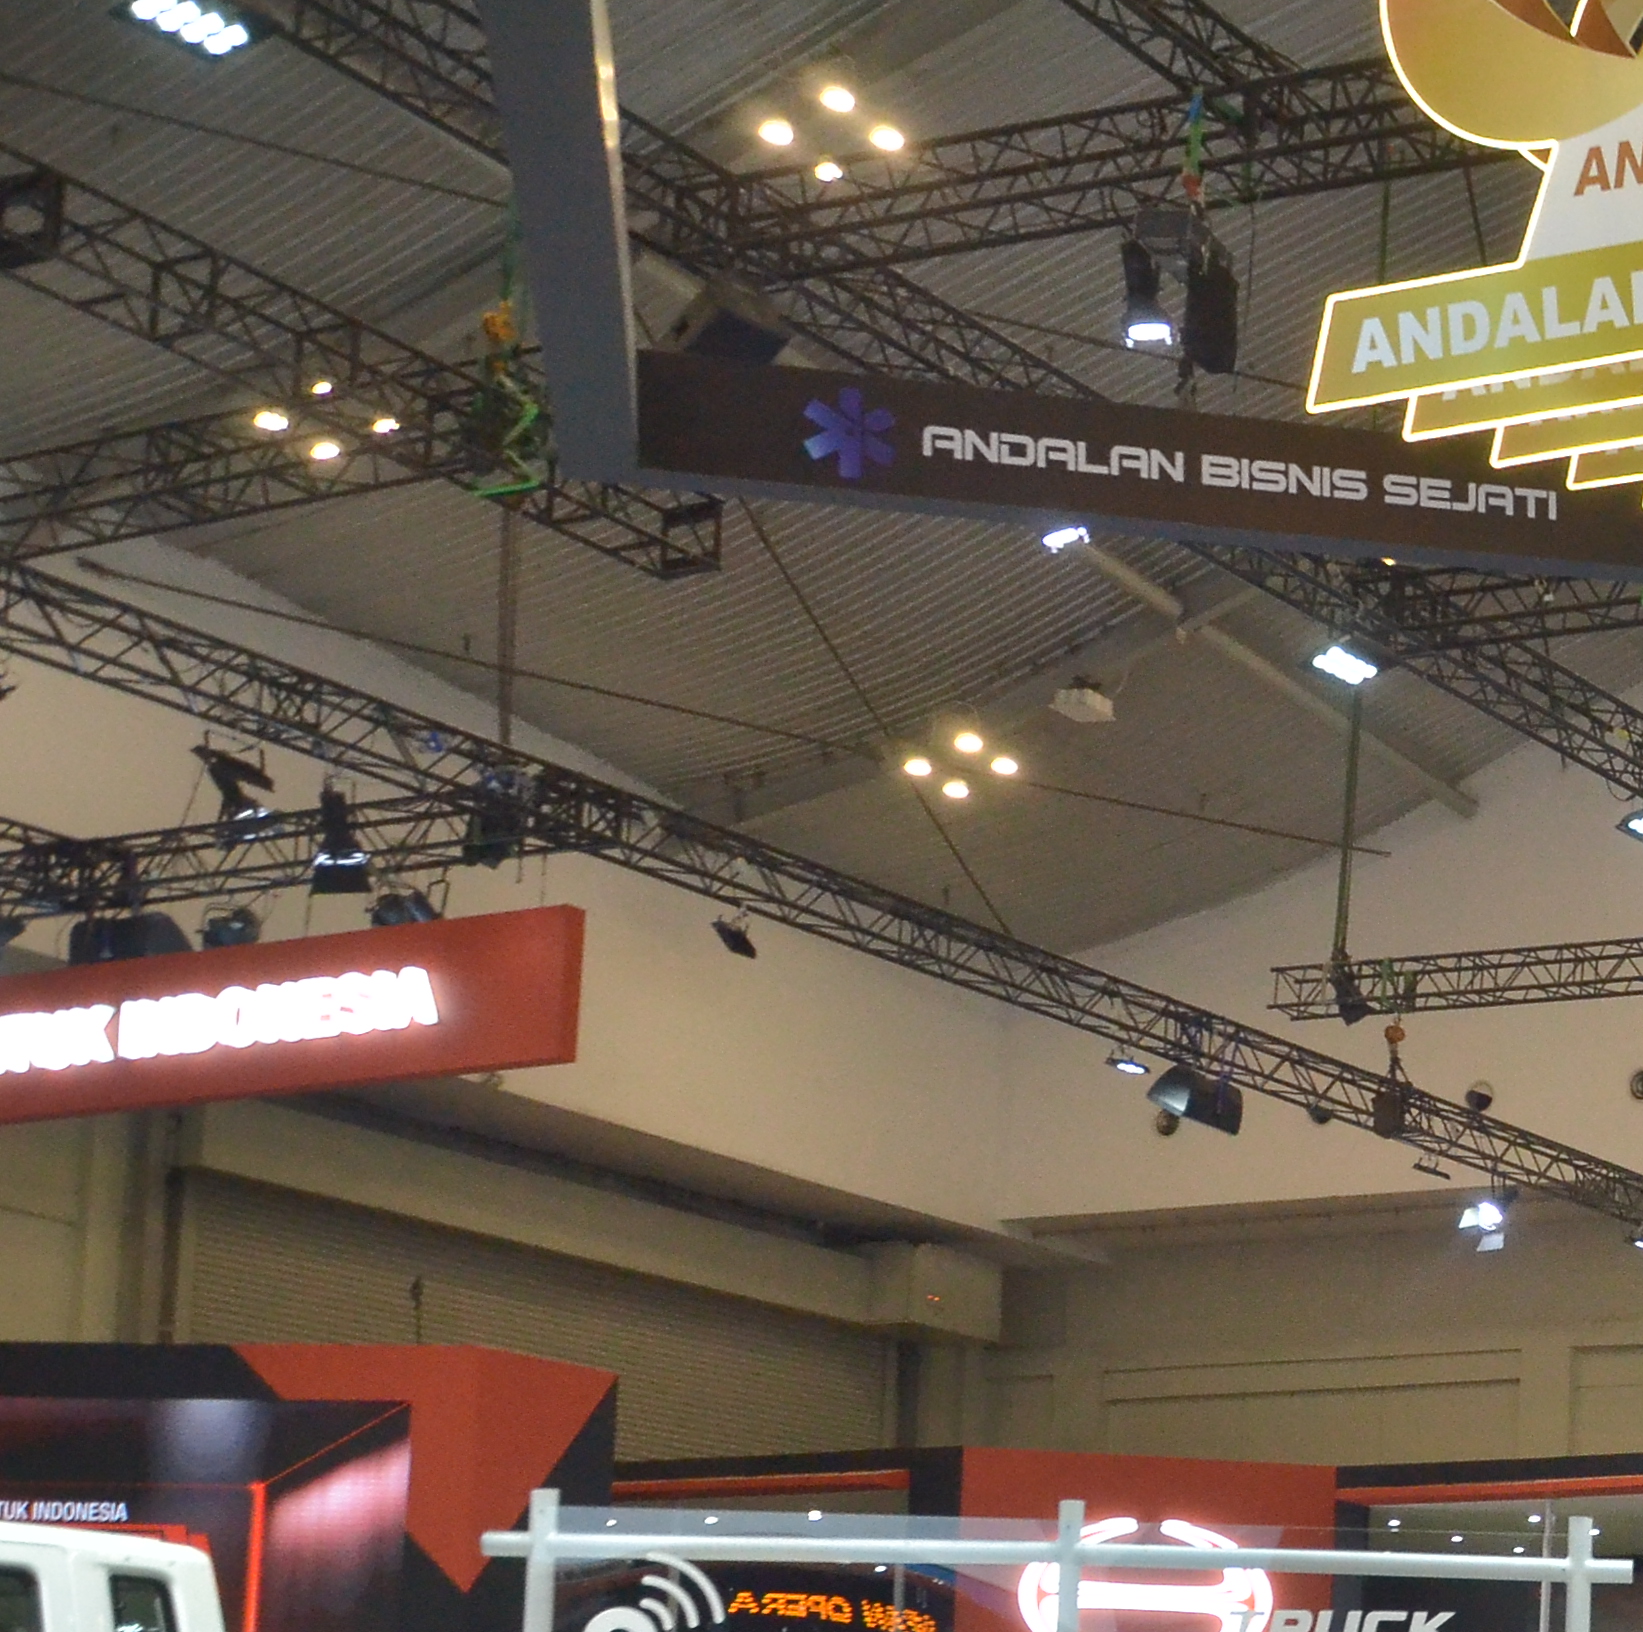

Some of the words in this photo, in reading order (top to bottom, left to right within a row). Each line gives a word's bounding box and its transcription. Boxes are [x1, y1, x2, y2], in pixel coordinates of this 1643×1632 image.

[921, 424, 1188, 483] ANDALAN
[1200, 455, 1369, 502] BISNIS
[1383, 474, 1558, 522] SEJATI
[32, 1500, 129, 1522] INDONESIA
